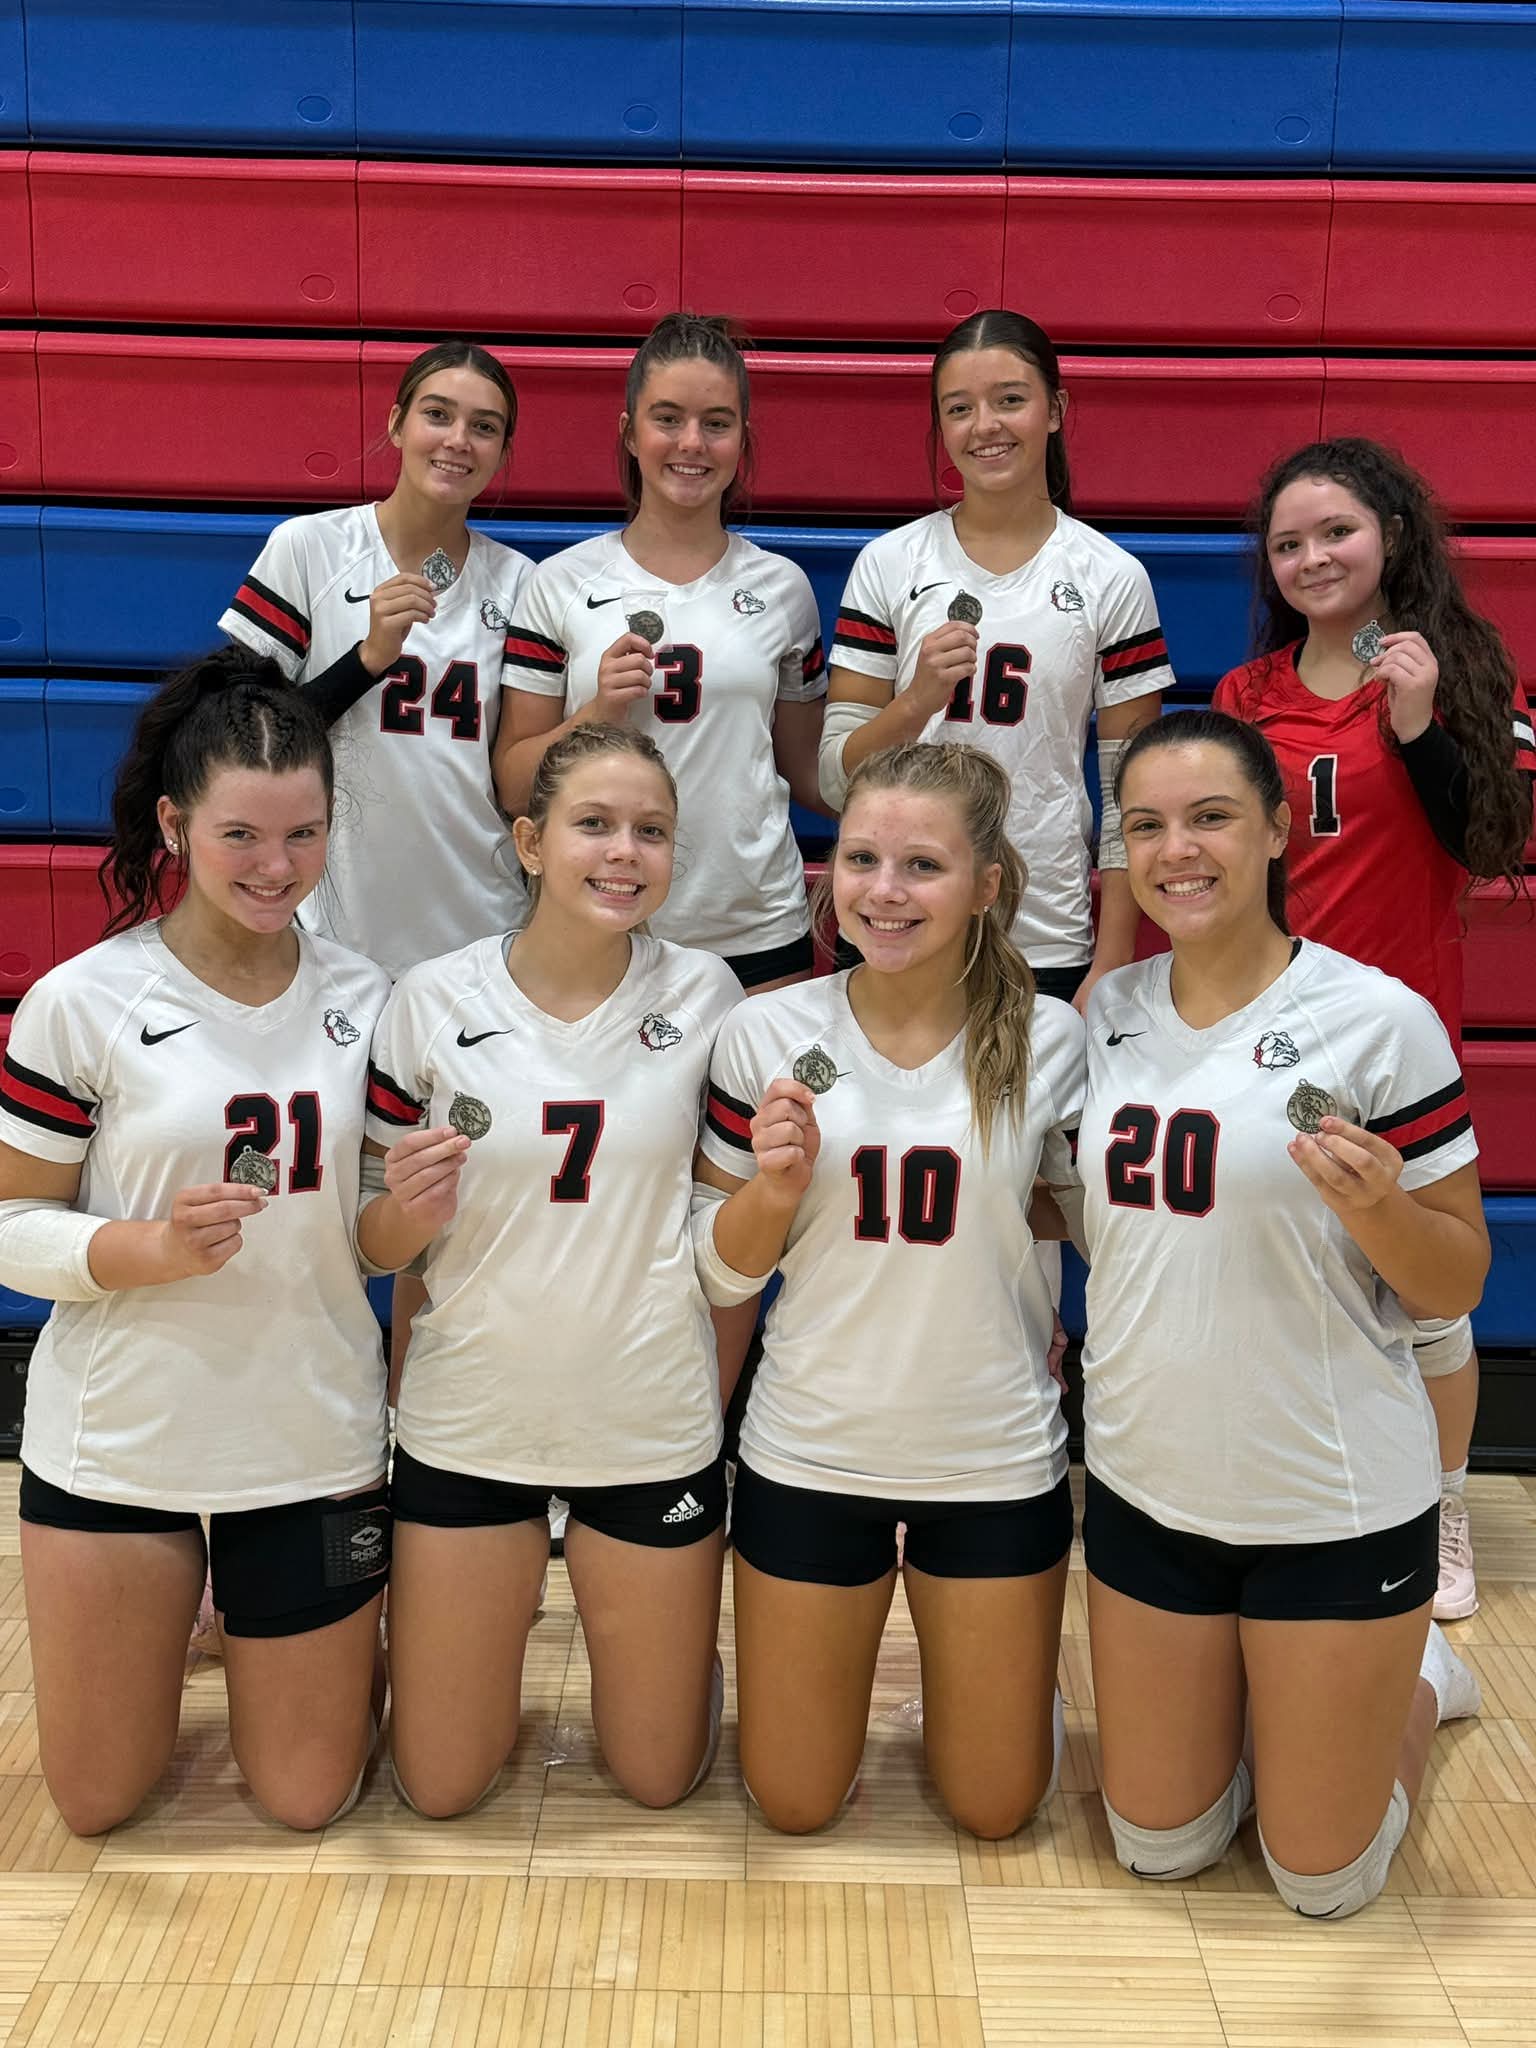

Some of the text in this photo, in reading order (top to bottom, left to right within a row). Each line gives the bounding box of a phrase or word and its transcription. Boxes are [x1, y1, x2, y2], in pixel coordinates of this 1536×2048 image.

[380, 653, 482, 742] 24
[654, 643, 703, 724] 3
[1307, 754, 1341, 837] 1
[223, 1091, 323, 1195] 21
[542, 1099, 605, 1203] 7
[1104, 1102, 1221, 1218] 20
[850, 1145, 962, 1246] 10
[663, 1504, 704, 1523] adidas
